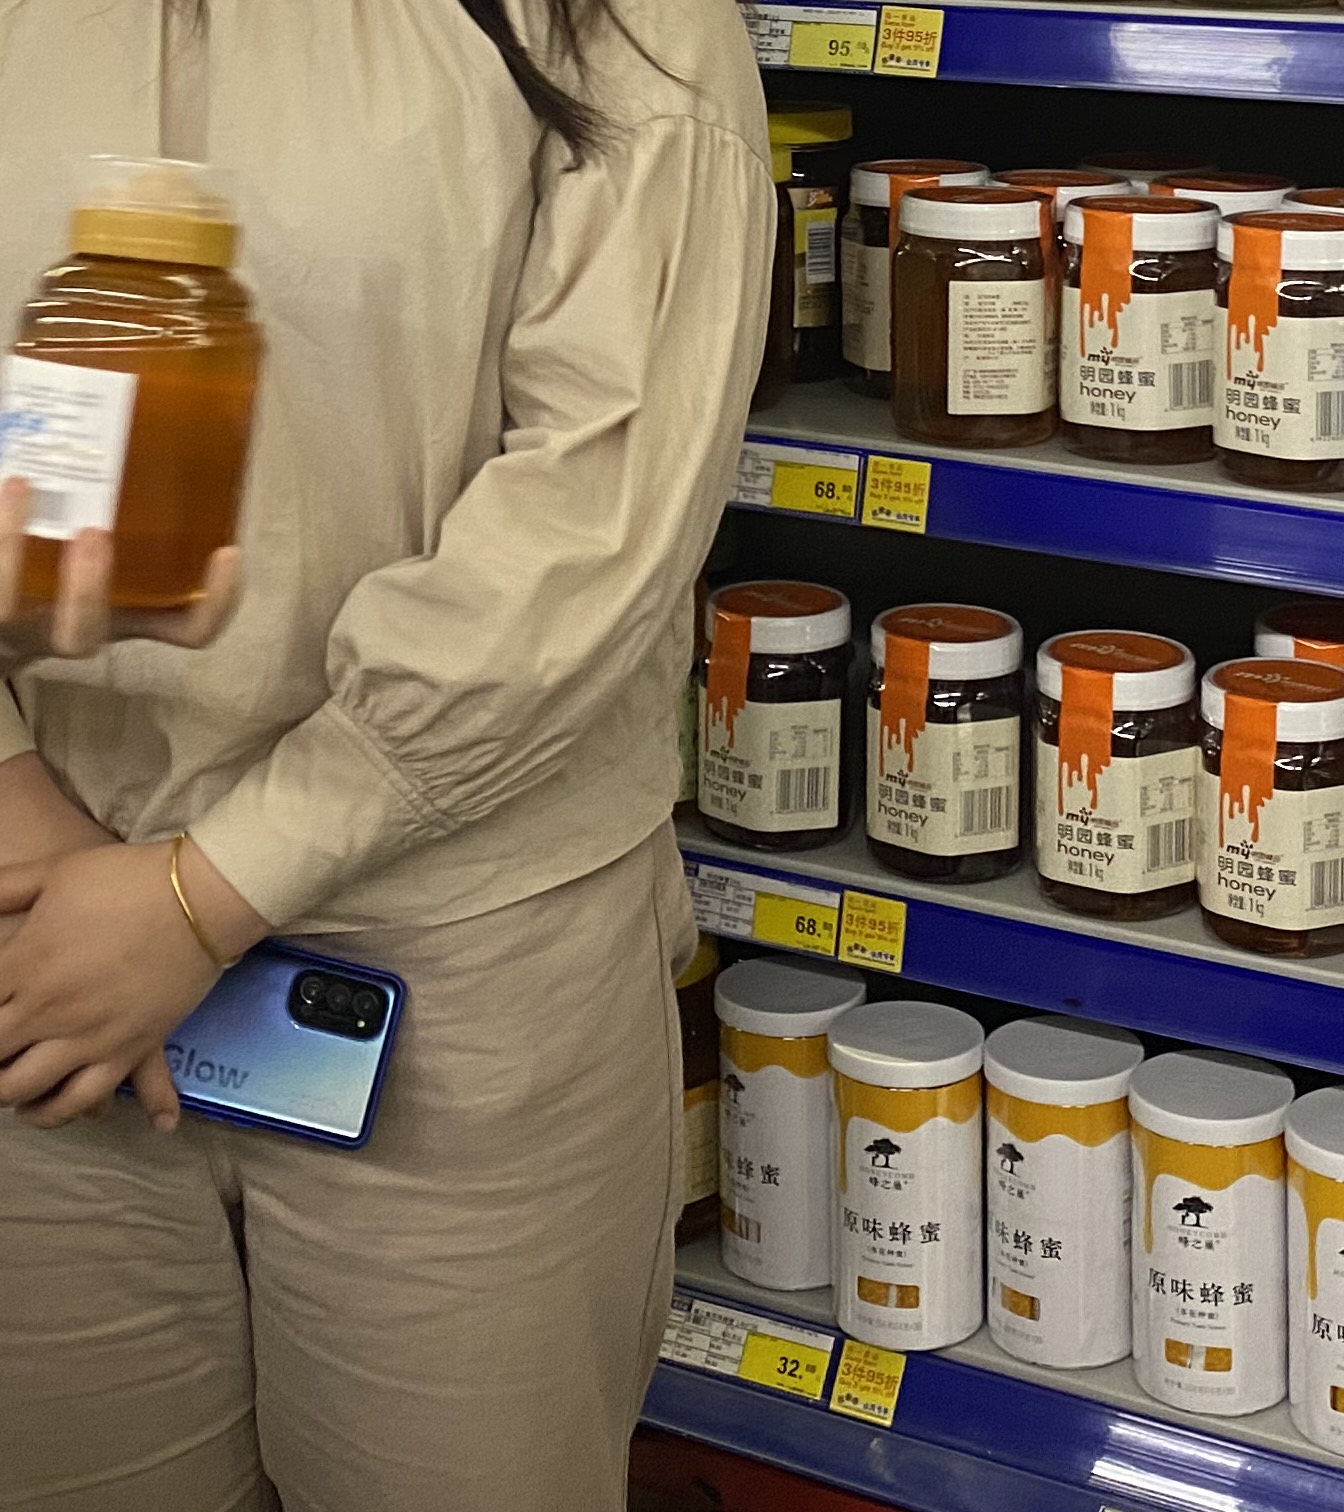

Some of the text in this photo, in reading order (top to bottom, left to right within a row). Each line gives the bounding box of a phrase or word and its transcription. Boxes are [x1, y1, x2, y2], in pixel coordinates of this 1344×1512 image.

[882, 27, 938, 47] 3件95折
[1079, 365, 1156, 387] 明园蜂蜜
[1079, 383, 1136, 403] honey
[1225, 388, 1302, 415] 明园蜂蜜
[1225, 407, 1281, 430] honey
[870, 475, 926, 499] 3件95折
[879, 783, 948, 813] 明园蜂蜜
[877, 802, 928, 827] honey
[1057, 823, 1135, 850] 明园蜂蜜
[1057, 840, 1116, 865] honey
[1217, 856, 1297, 887] 明园蜂蜜
[1216, 873, 1276, 900] honey
[845, 911, 901, 935] 3件95折
[842, 1205, 941, 1245] 原味蜂蜜
[1149, 1268, 1255, 1307] 原味蜂蜜
[840, 1361, 898, 1391] 3件95折
